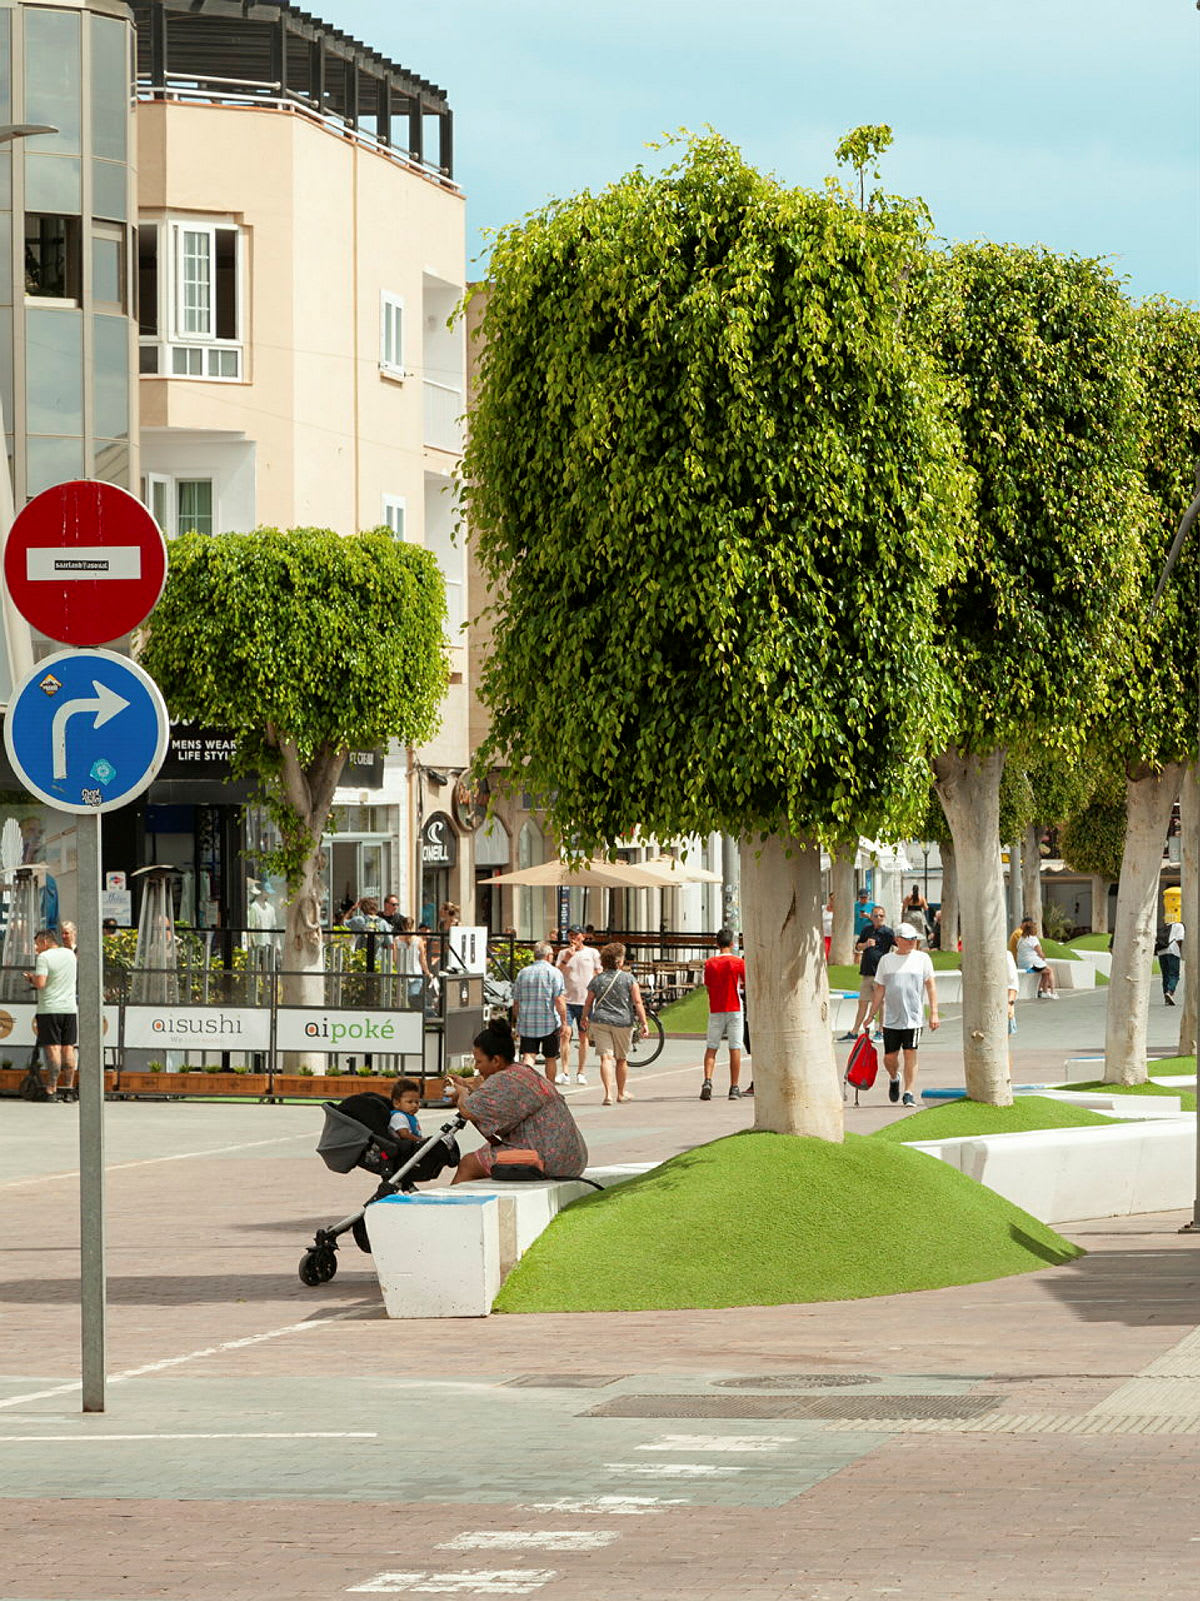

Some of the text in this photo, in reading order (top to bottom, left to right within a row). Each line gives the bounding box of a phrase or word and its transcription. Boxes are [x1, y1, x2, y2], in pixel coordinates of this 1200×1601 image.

[171, 739, 202, 750] MENS
[177, 750, 201, 761] LIFE
[151, 1013, 243, 1034] aisushi
[304, 1017, 395, 1044] aipoké
